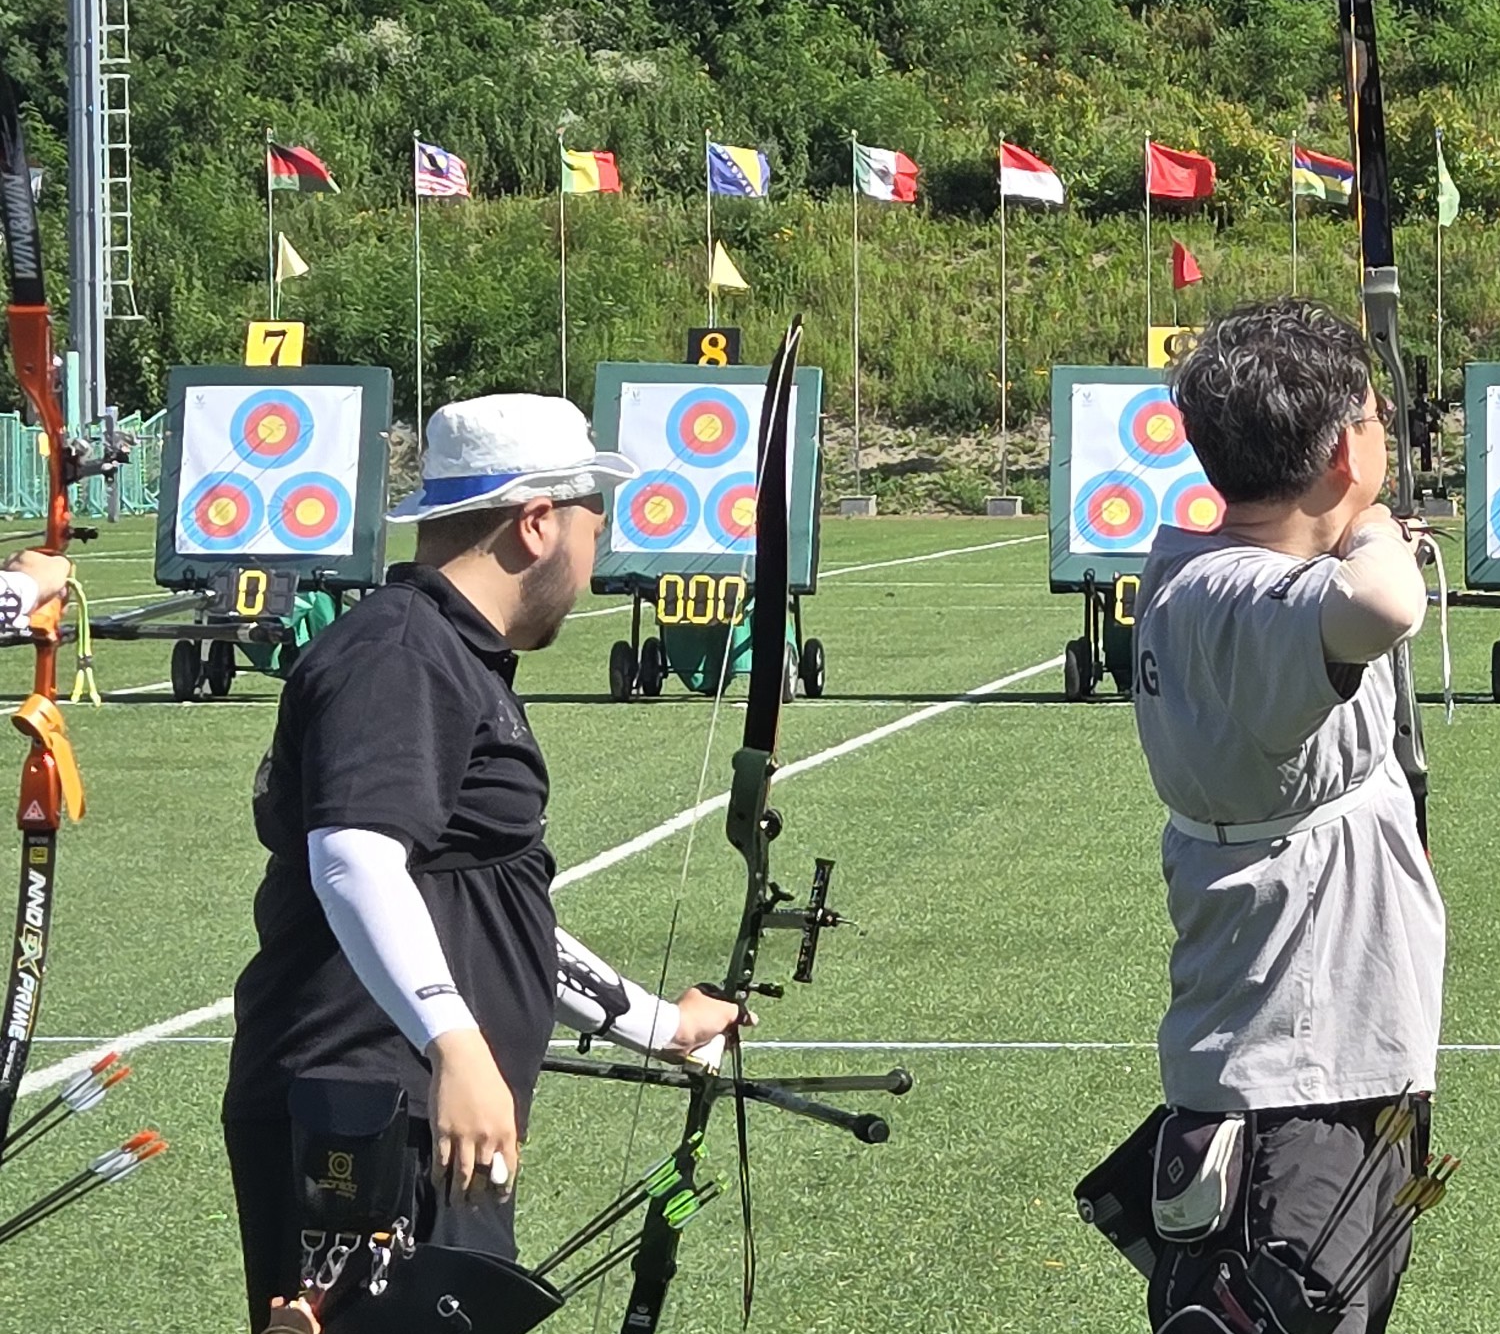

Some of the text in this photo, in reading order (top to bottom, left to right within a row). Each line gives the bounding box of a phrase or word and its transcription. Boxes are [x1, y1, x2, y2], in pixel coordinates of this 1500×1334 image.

[2, 172, 38, 278] WIN&WIN
[263, 329, 289, 366] 7
[698, 332, 728, 366] 8
[235, 569, 267, 617] 0
[657, 574, 747, 625] 000
[25, 867, 47, 928] INNO
[7, 970, 38, 1042] PRIME
